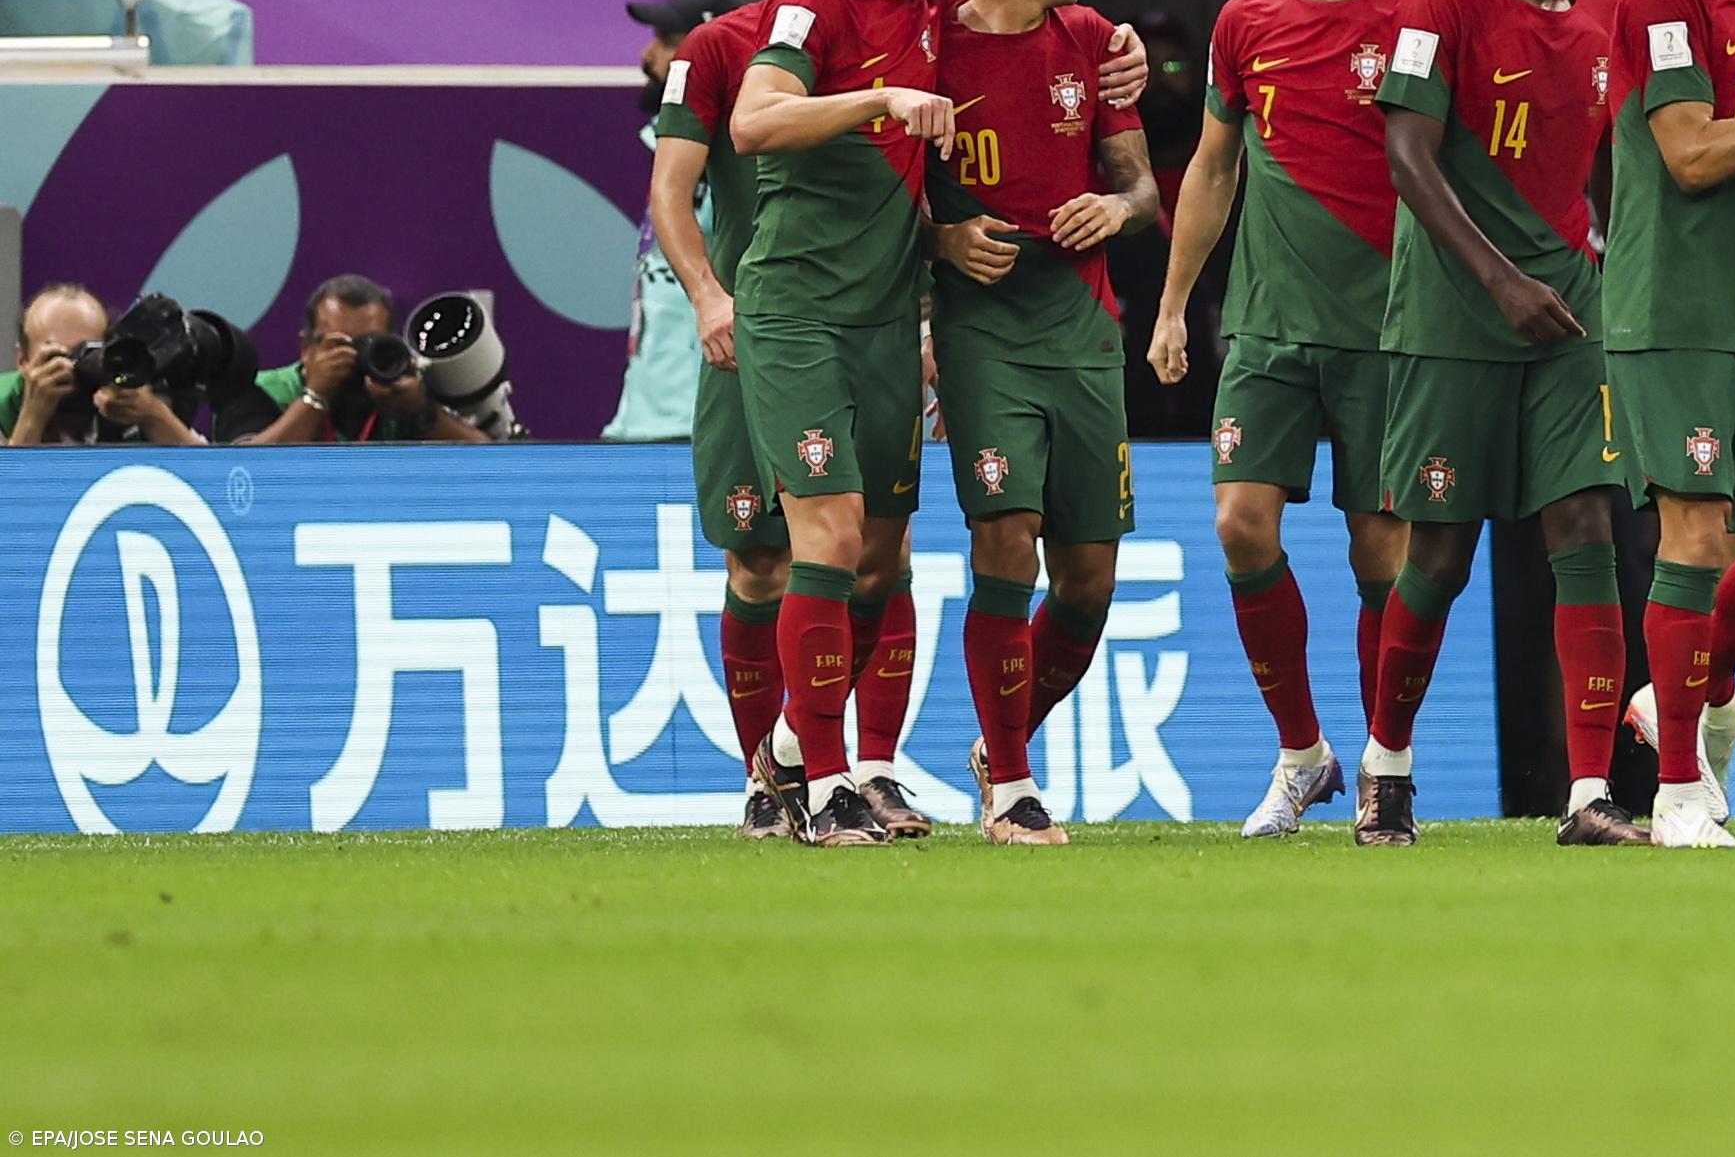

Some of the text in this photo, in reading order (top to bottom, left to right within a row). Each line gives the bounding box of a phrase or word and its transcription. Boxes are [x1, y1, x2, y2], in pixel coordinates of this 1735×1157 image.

[1258, 85, 1276, 139] 7
[1489, 99, 1529, 159] 14
[956, 129, 1001, 185] 20
